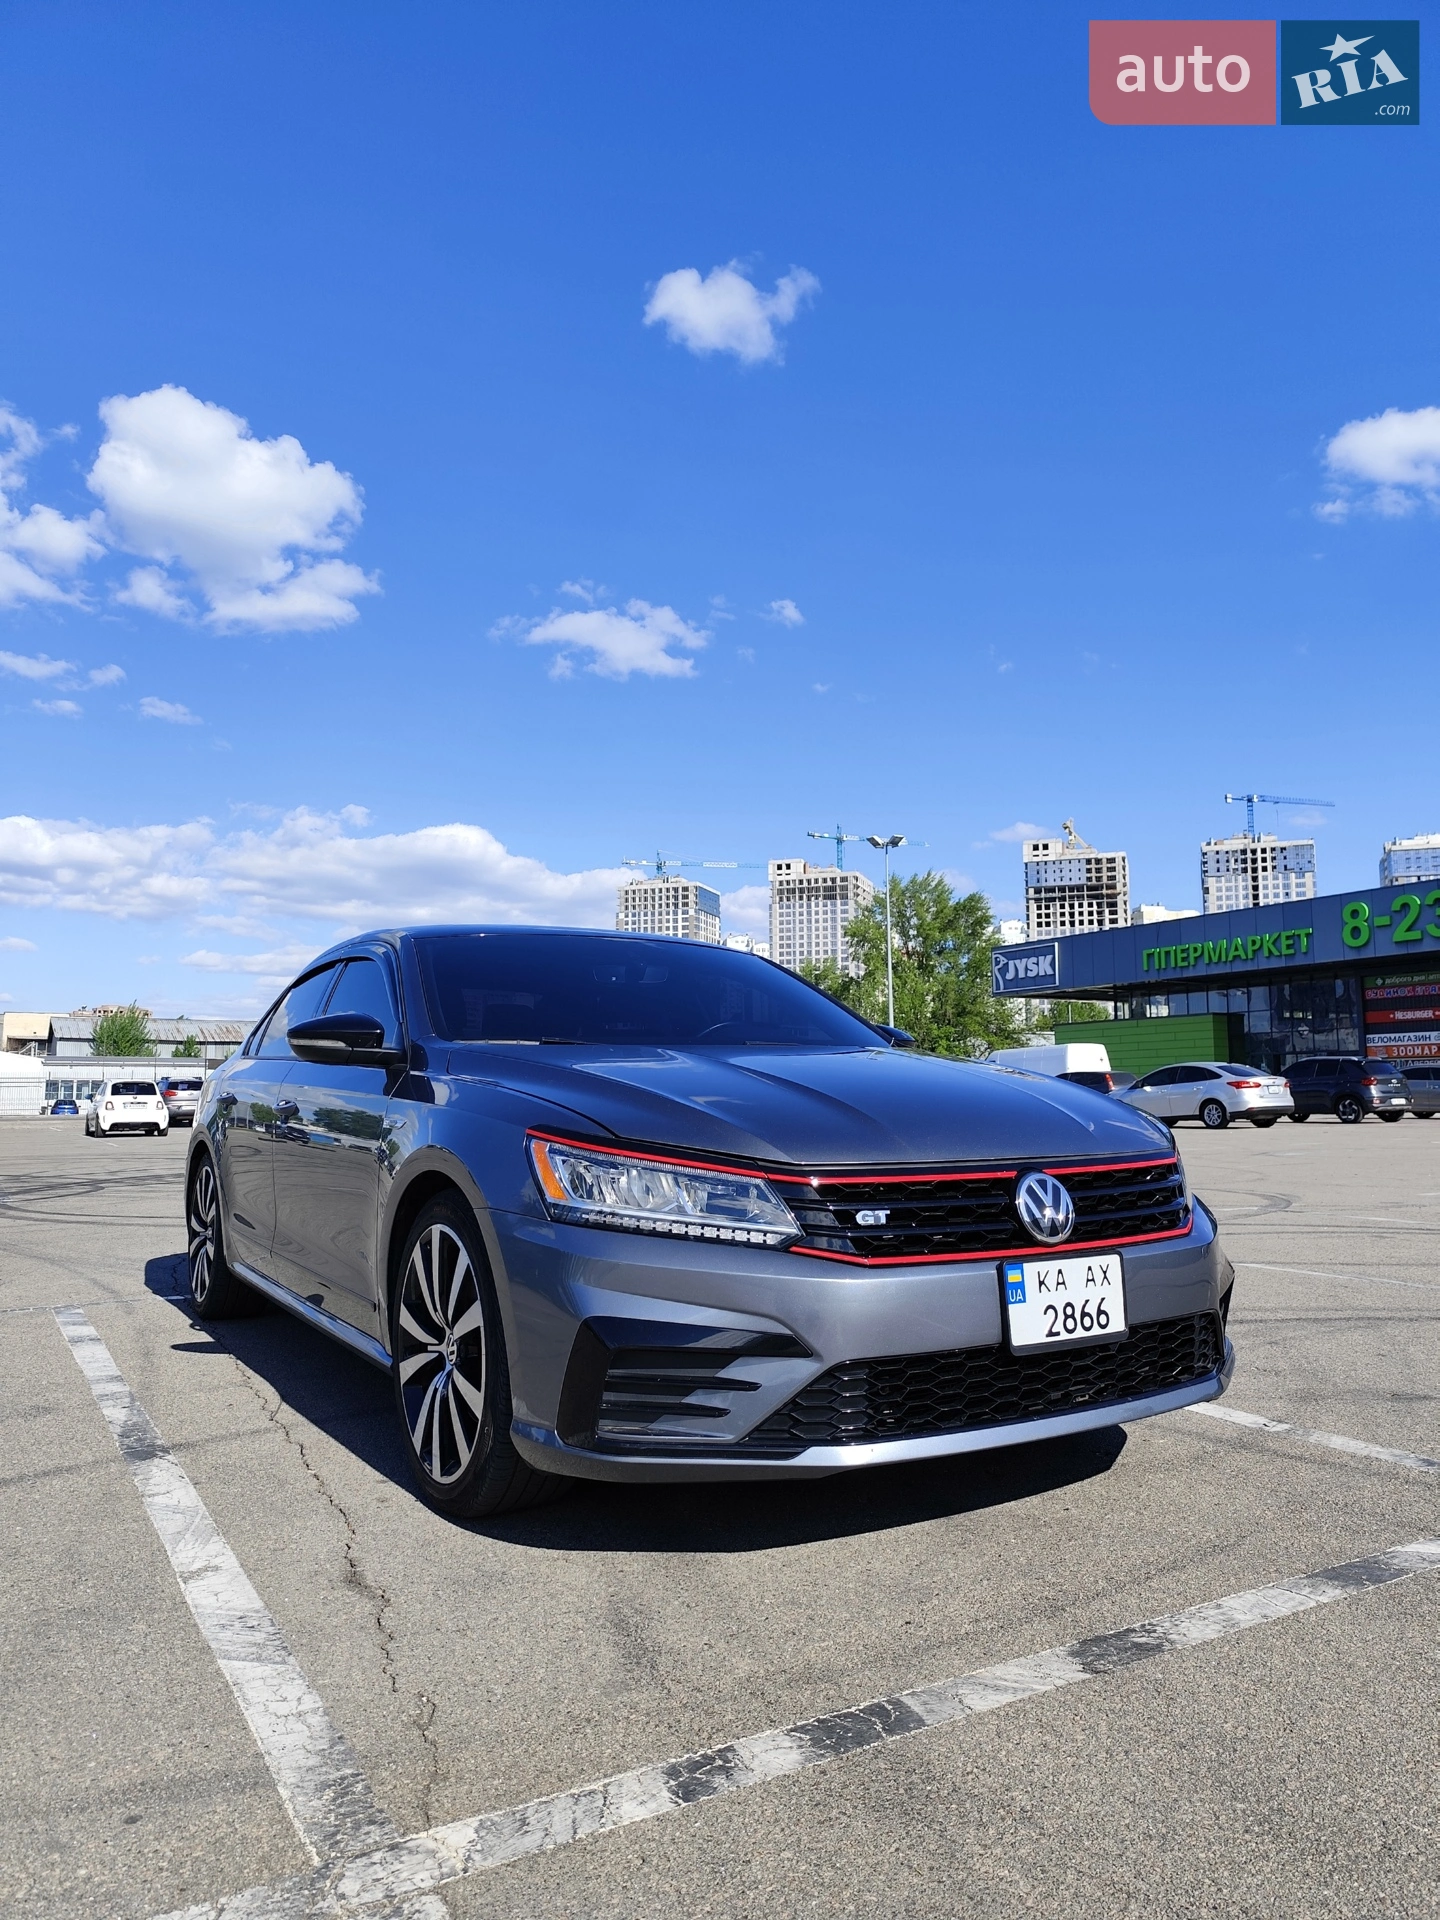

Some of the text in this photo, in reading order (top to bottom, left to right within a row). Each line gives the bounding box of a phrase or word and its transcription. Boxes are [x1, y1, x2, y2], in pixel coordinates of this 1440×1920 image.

[1142, 927, 1313, 971] ГІПЕРМАРКЕТ
[1005, 954, 1054, 980] JYSK
[1366, 986, 1414, 999] БУДИНОК
[1394, 1010, 1435, 1020] HESBURGER
[1366, 1034, 1431, 1045] ВЕЛОМАГАЗИН
[855, 1210, 890, 1226] GT
[1037, 1263, 1111, 1293] KA AX
[1008, 1288, 1024, 1302] UA
[1043, 1297, 1110, 1338] 2866
